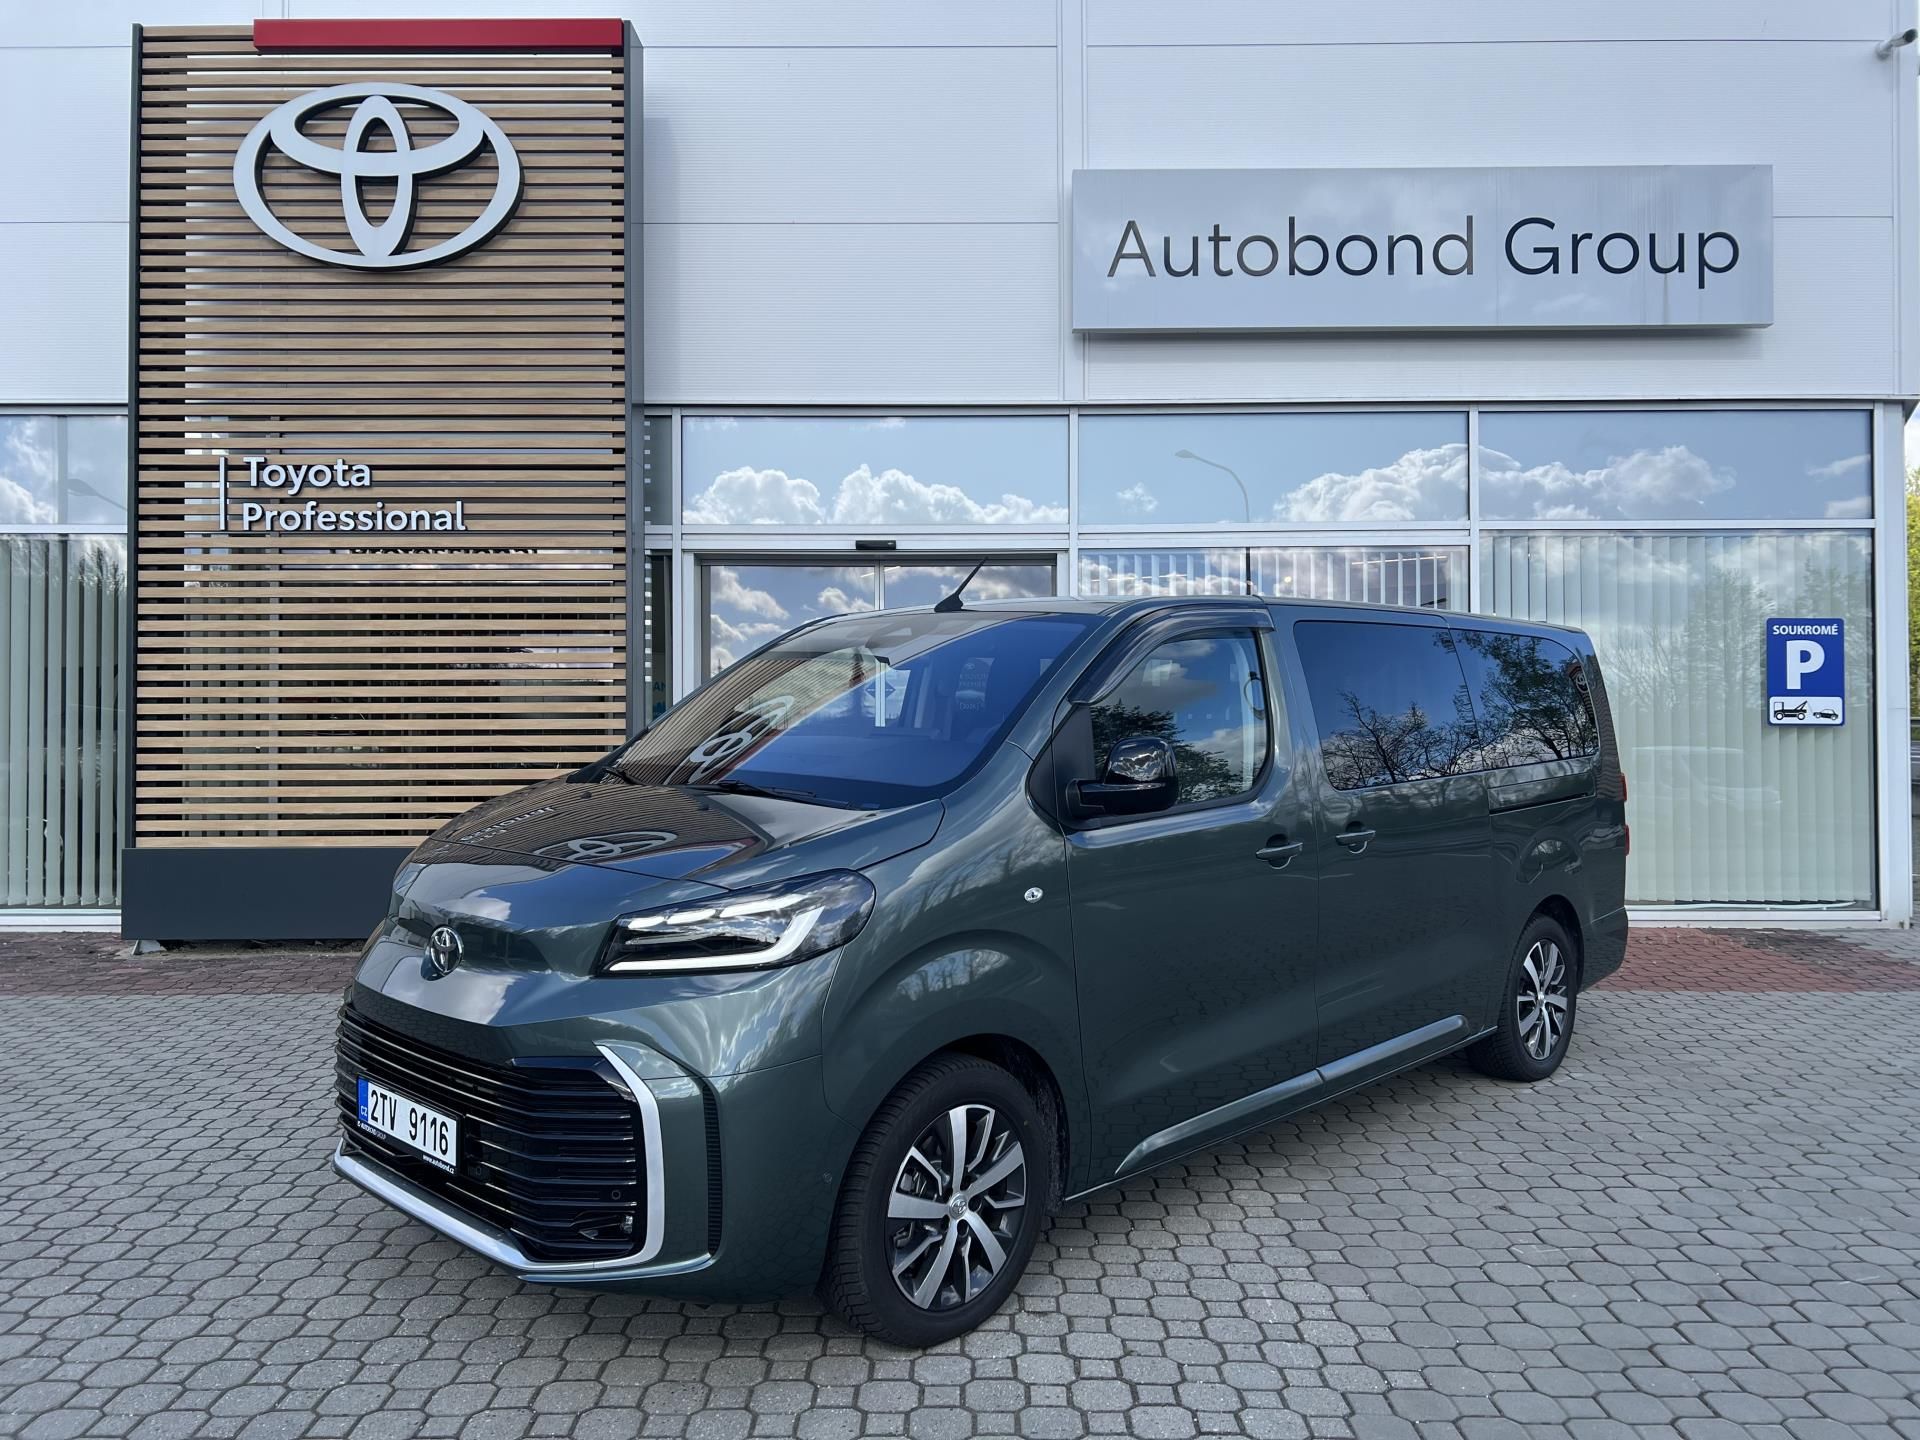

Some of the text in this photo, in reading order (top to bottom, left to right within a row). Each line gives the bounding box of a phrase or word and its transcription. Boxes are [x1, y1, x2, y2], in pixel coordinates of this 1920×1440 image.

[1107, 215, 1740, 289] Autobond Group
[243, 456, 373, 495] Toyota
[243, 501, 466, 531] Professional
[1773, 624, 1839, 636] SOUKROMÉ
[1786, 640, 1825, 690] P
[360, 1105, 368, 1117] CZ
[370, 1089, 397, 1131] 2TV
[409, 1107, 449, 1156] 9116
